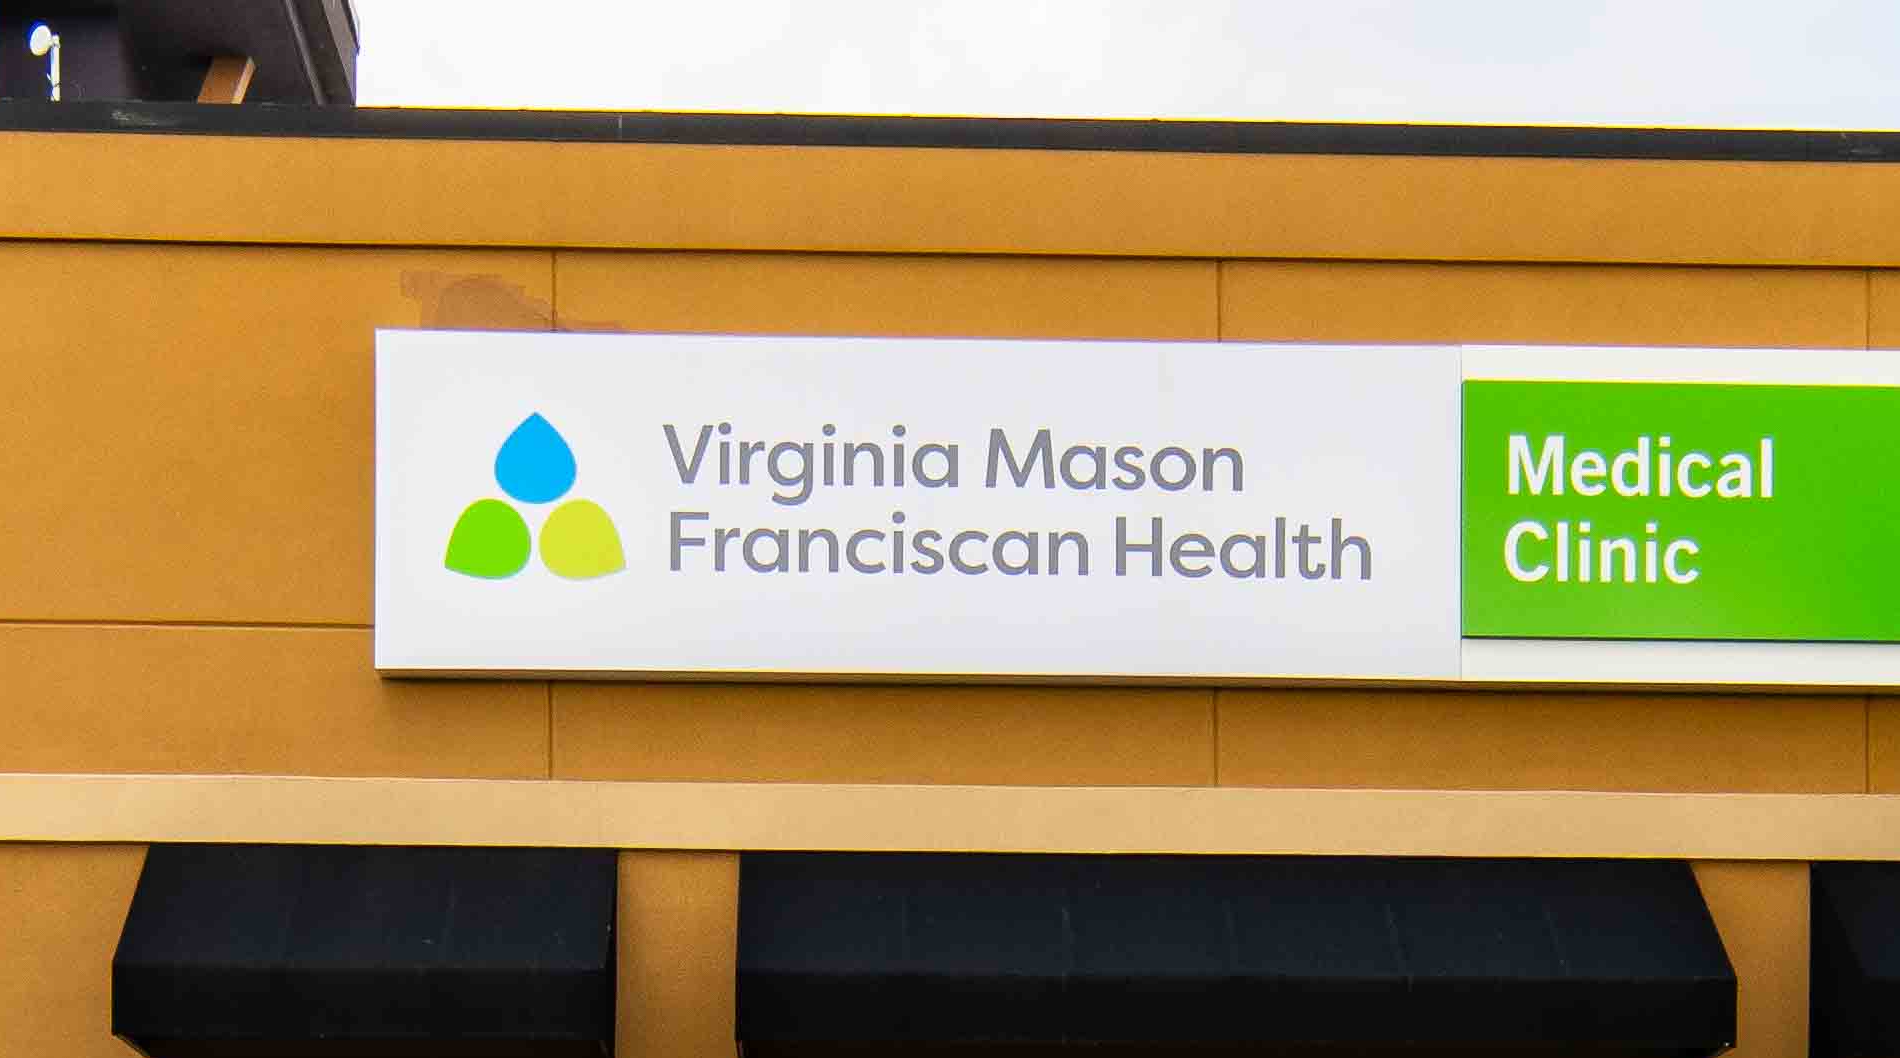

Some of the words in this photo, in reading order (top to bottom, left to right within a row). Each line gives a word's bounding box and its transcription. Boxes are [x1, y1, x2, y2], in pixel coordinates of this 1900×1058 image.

[662, 422, 959, 506] Virginia
[985, 428, 1244, 492] Mason
[1508, 435, 1774, 498] Medical
[670, 511, 1089, 577] Franciscan
[1115, 516, 1372, 580] Health
[1504, 520, 1700, 584] Clinic
